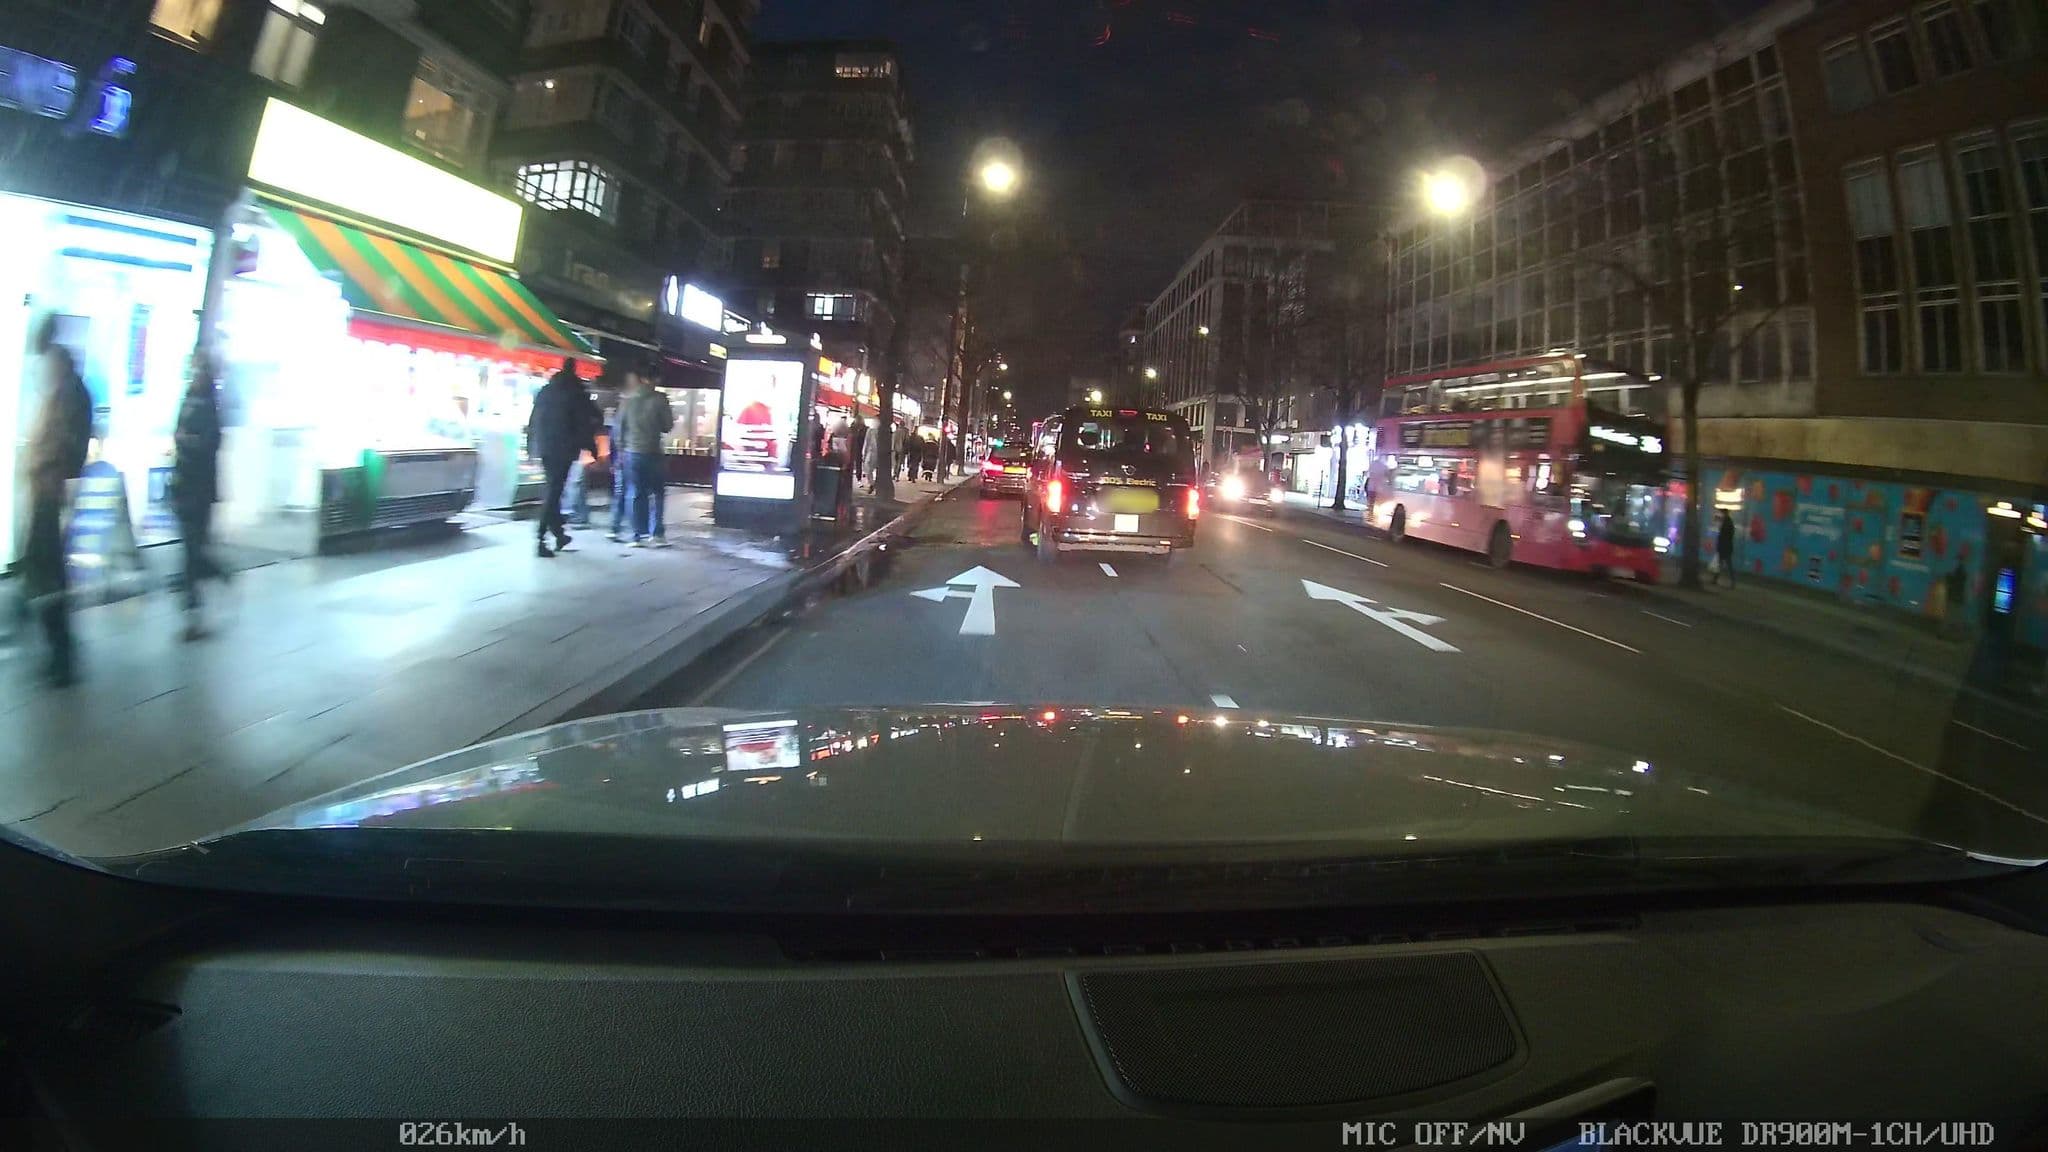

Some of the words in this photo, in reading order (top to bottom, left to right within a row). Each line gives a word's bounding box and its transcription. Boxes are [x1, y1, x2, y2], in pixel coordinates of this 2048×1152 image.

[1090, 409, 1113, 418] TAXI
[1146, 412, 1168, 421] TAXI
[1126, 477, 1157, 487] Electric
